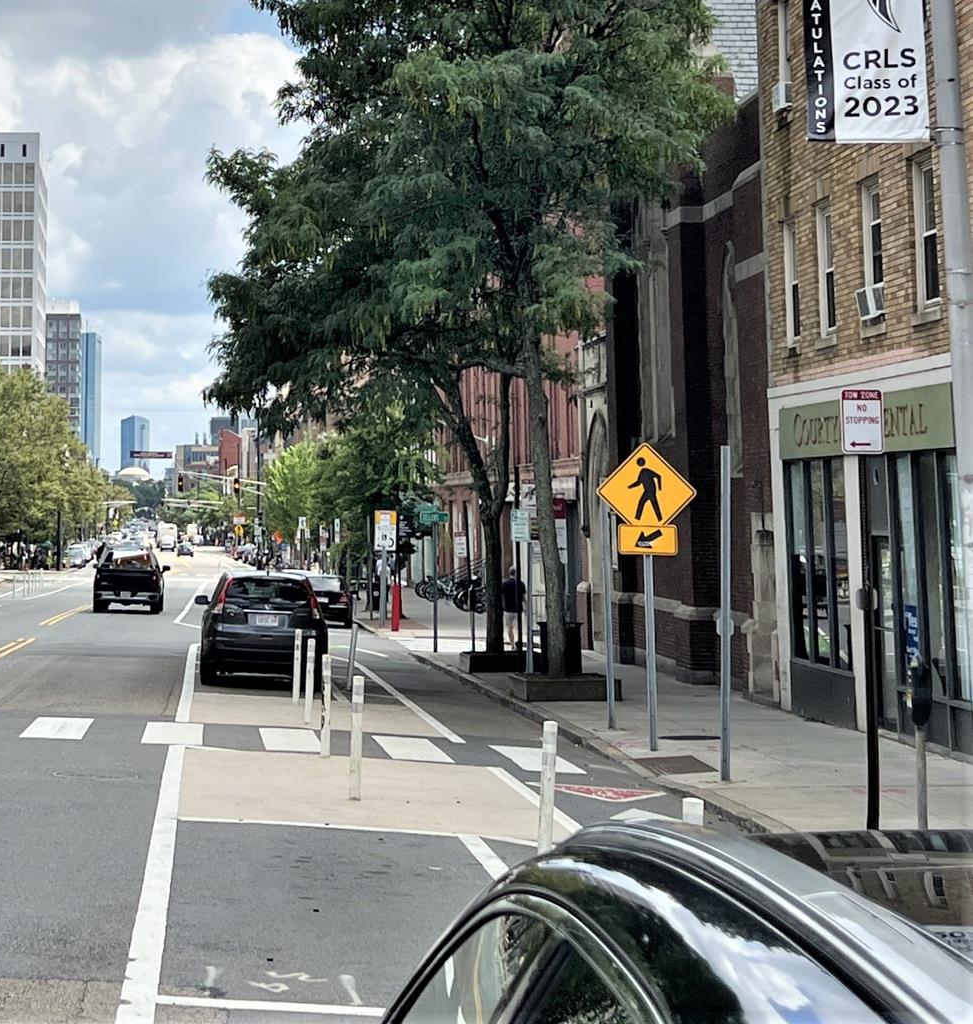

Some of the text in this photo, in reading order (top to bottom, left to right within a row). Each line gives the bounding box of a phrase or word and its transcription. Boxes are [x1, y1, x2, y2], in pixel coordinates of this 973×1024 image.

[843, 48, 917, 70] CRLS
[844, 74, 917, 90] Class of
[844, 95, 919, 118] 2023
[844, 391, 879, 399] TOW ZONE
[856, 404, 868, 413] NO
[793, 404, 928, 447] COURTY ENTAL
[845, 416, 880, 425] STOPPING
